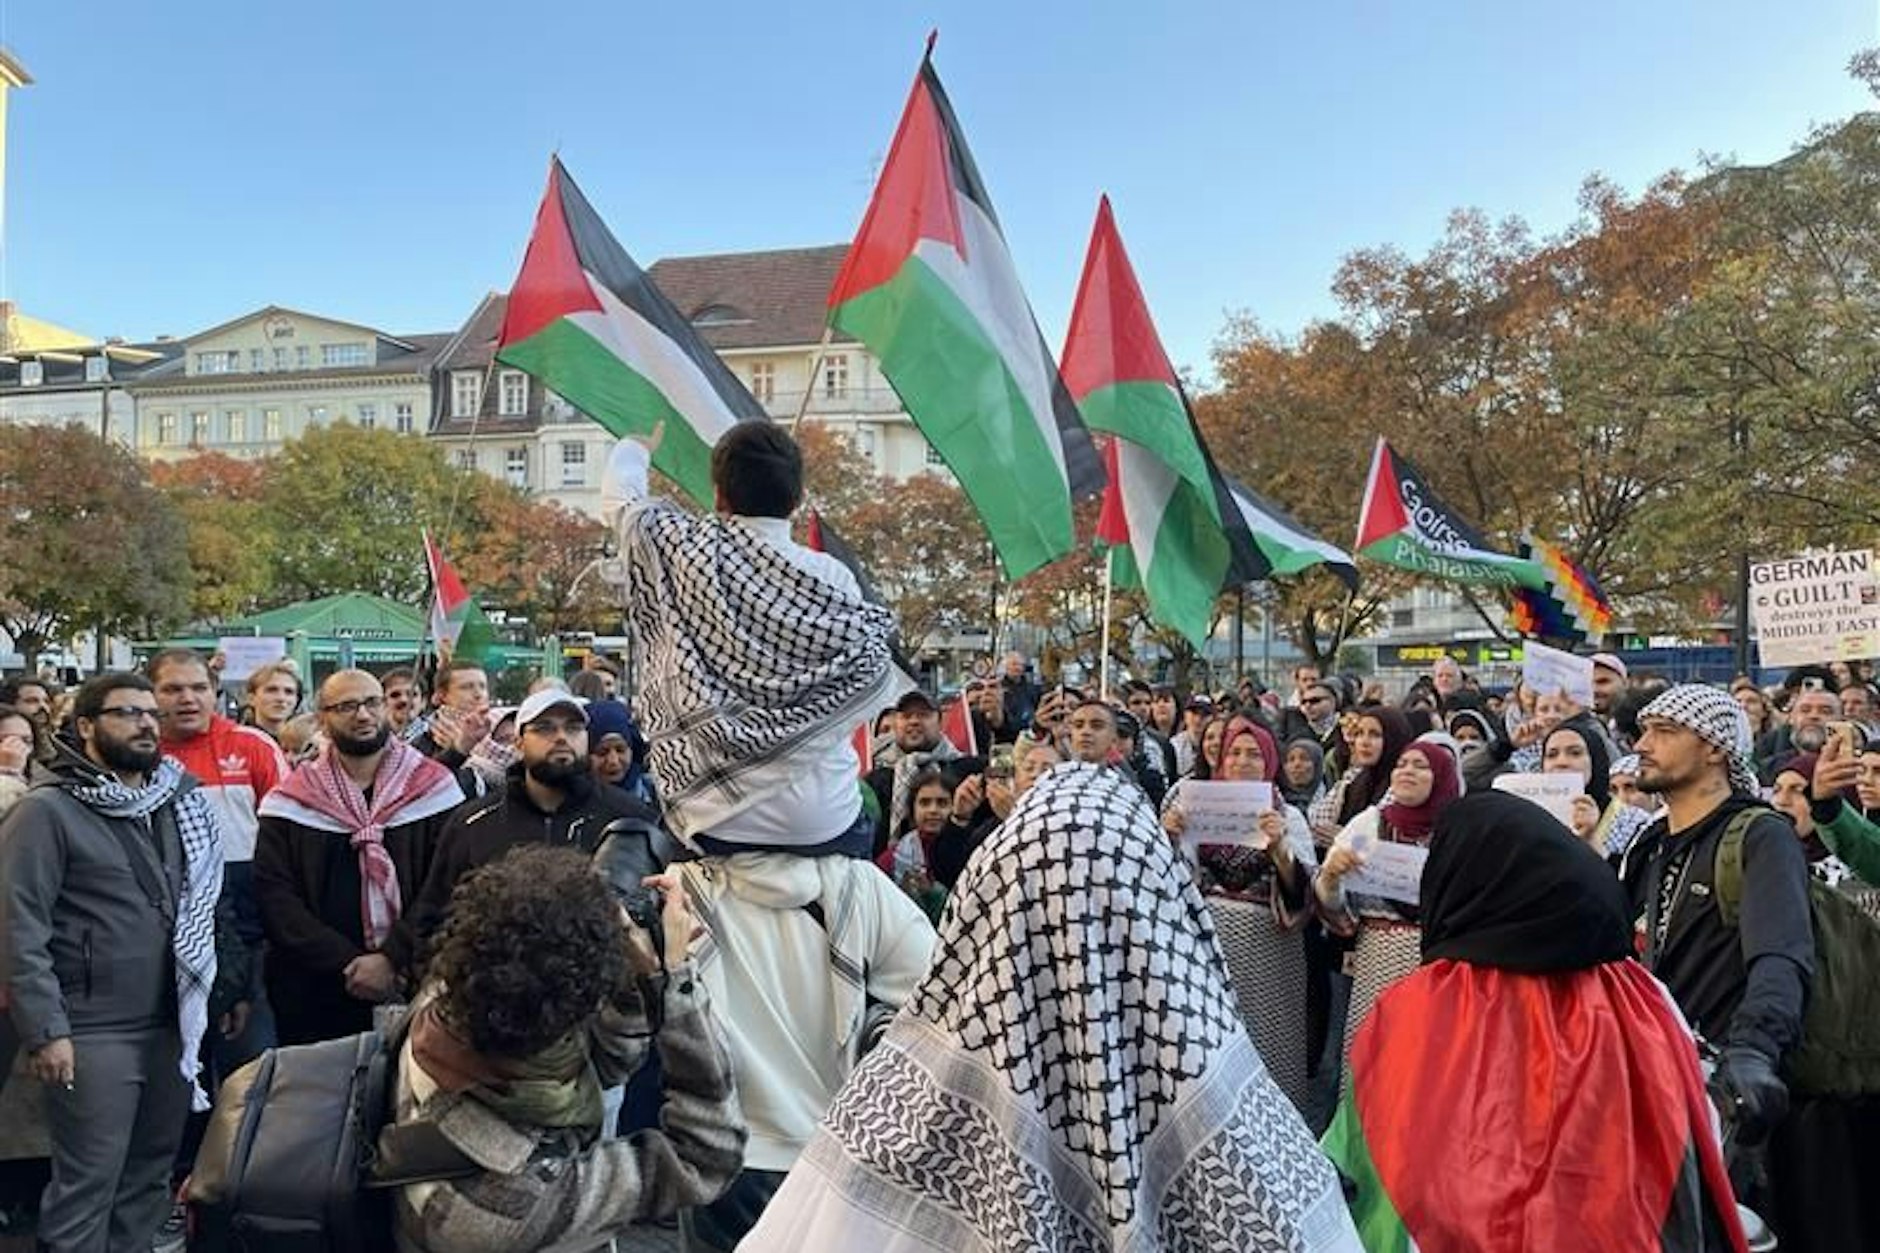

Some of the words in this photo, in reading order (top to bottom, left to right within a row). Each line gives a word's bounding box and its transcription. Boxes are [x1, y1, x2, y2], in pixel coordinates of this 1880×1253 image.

[1753, 553, 1868, 584] GERMAN
[1774, 581, 1853, 608] GUILT
[1770, 607, 1833, 623] destroys
[1837, 604, 1862, 616] the
[1762, 624, 1829, 640] MIDDLE
[1836, 617, 1879, 634] EAST
